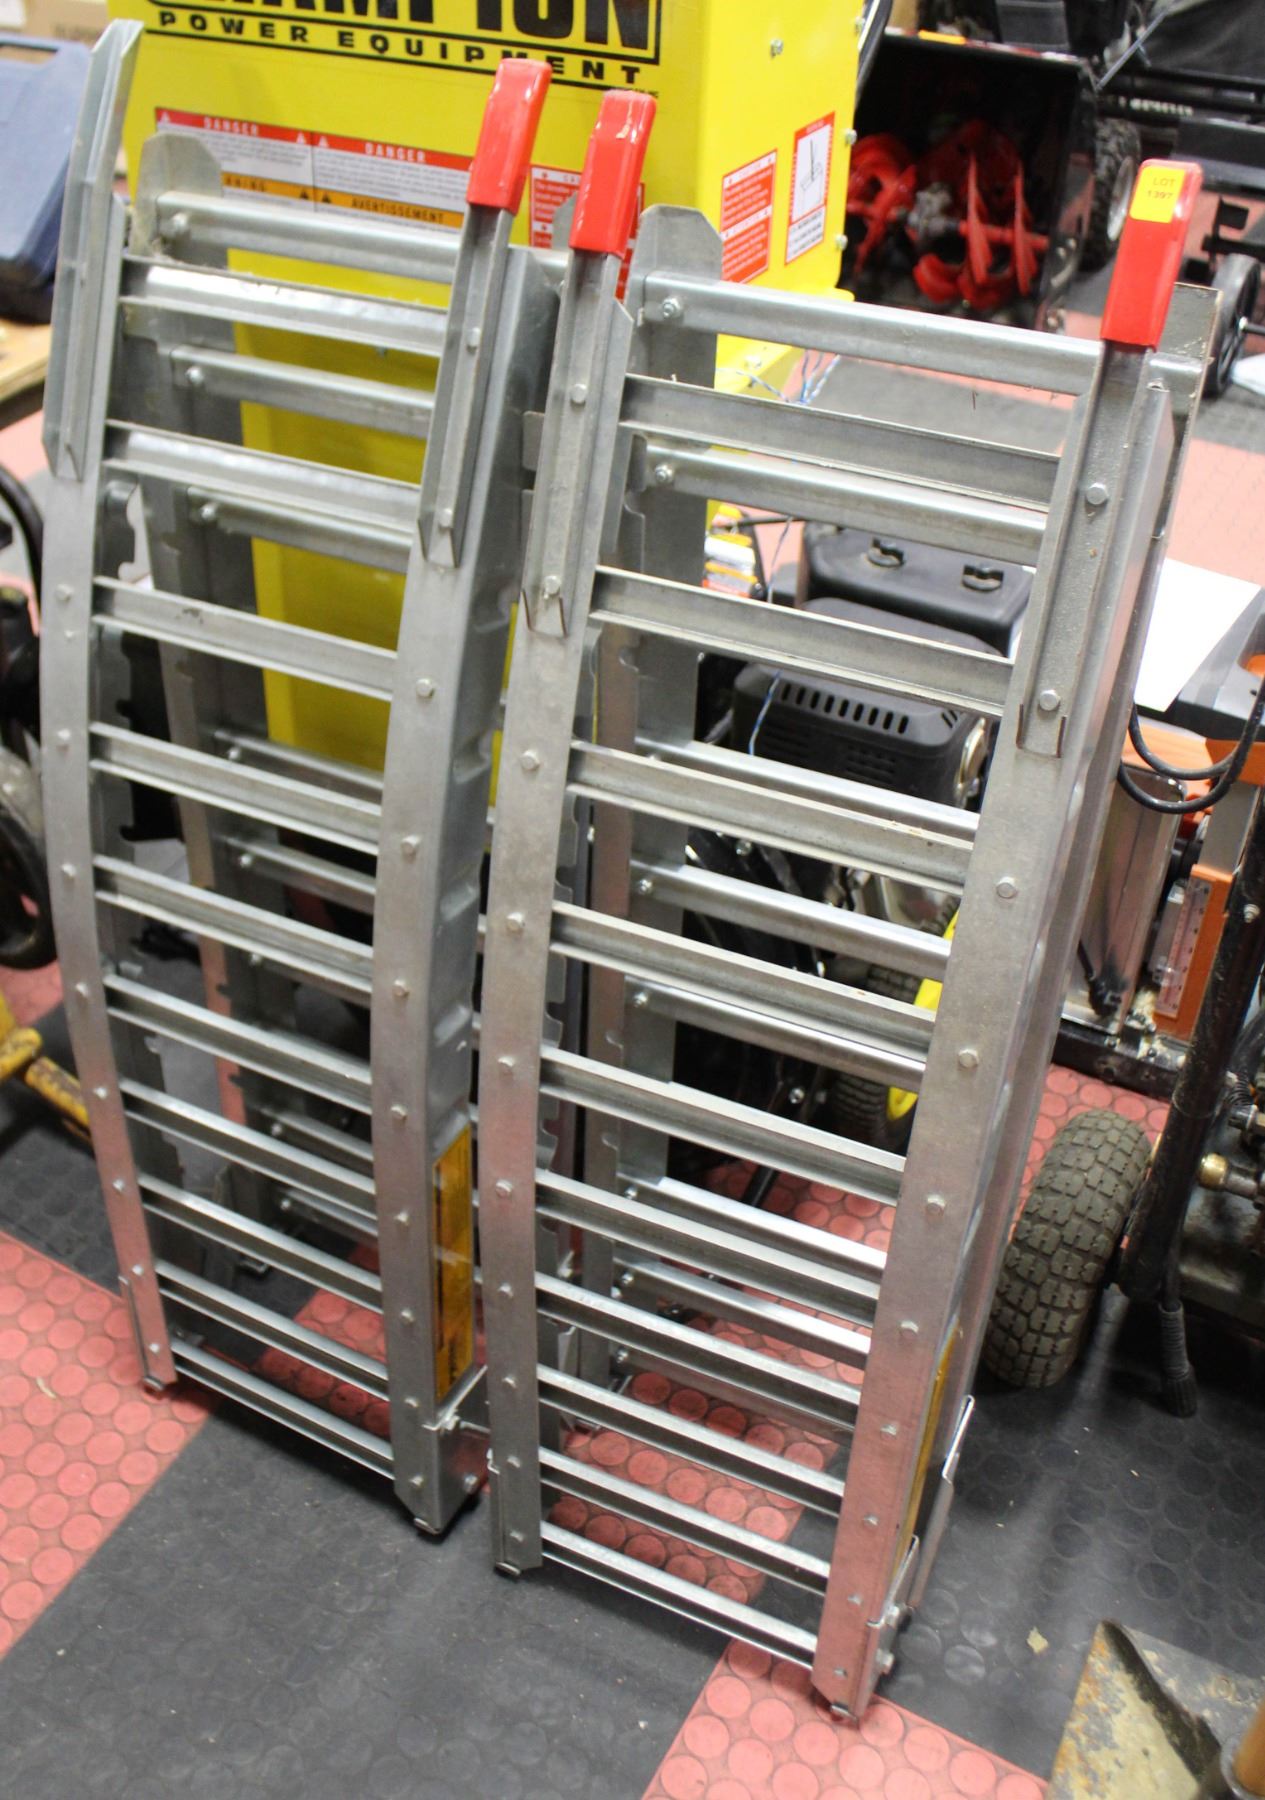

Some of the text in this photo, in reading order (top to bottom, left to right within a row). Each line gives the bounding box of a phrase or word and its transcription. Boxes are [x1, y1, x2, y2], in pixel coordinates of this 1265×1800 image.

[159, 11, 309, 43] POWER
[204, 116, 260, 136] DANGER
[365, 142, 426, 163] DANGER
[1152, 177, 1176, 188] LOT
[351, 198, 444, 225] AVERTISSEMENT
